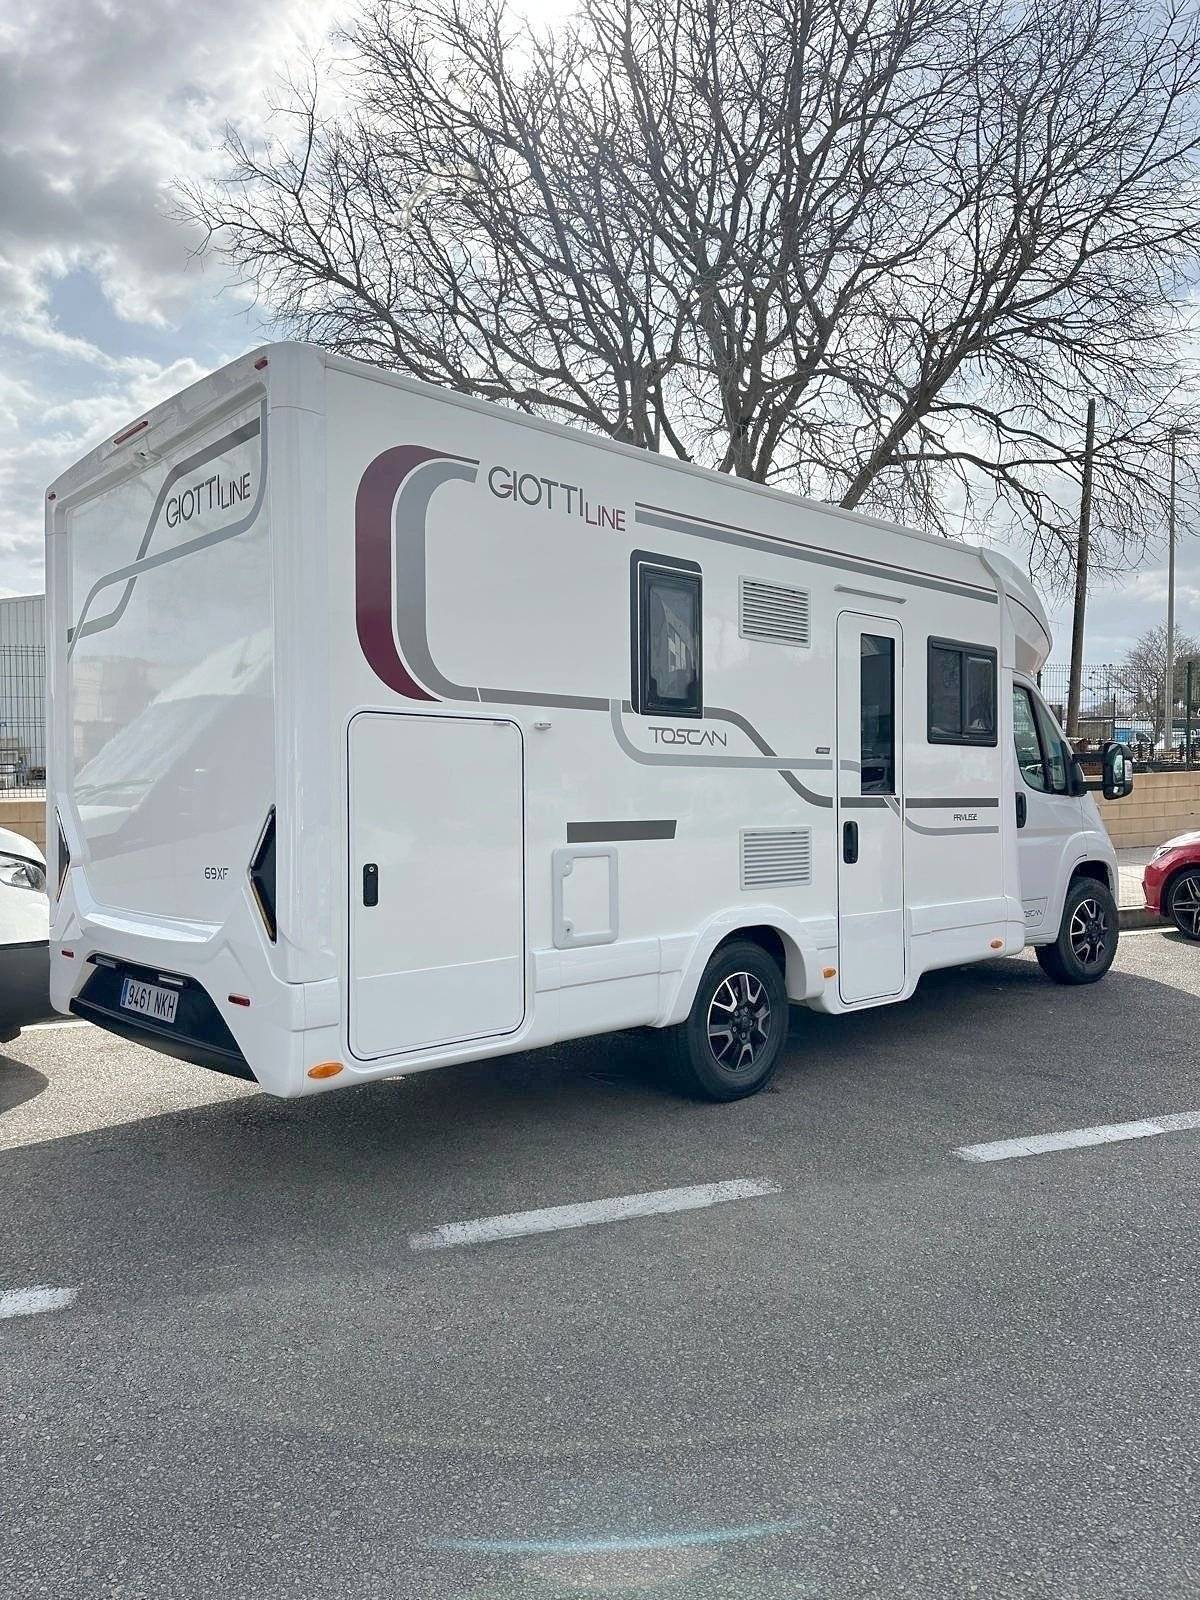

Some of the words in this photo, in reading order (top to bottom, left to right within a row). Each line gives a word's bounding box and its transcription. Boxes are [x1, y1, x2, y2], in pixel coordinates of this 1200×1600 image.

[166, 472, 250, 528] GIOTTILINE
[488, 466, 625, 532] GIOTTILINE
[648, 727, 727, 746] TOSCAN
[204, 867, 229, 880] 69XF
[128, 985, 152, 1010] 9461
[154, 992, 176, 1018] NKH
